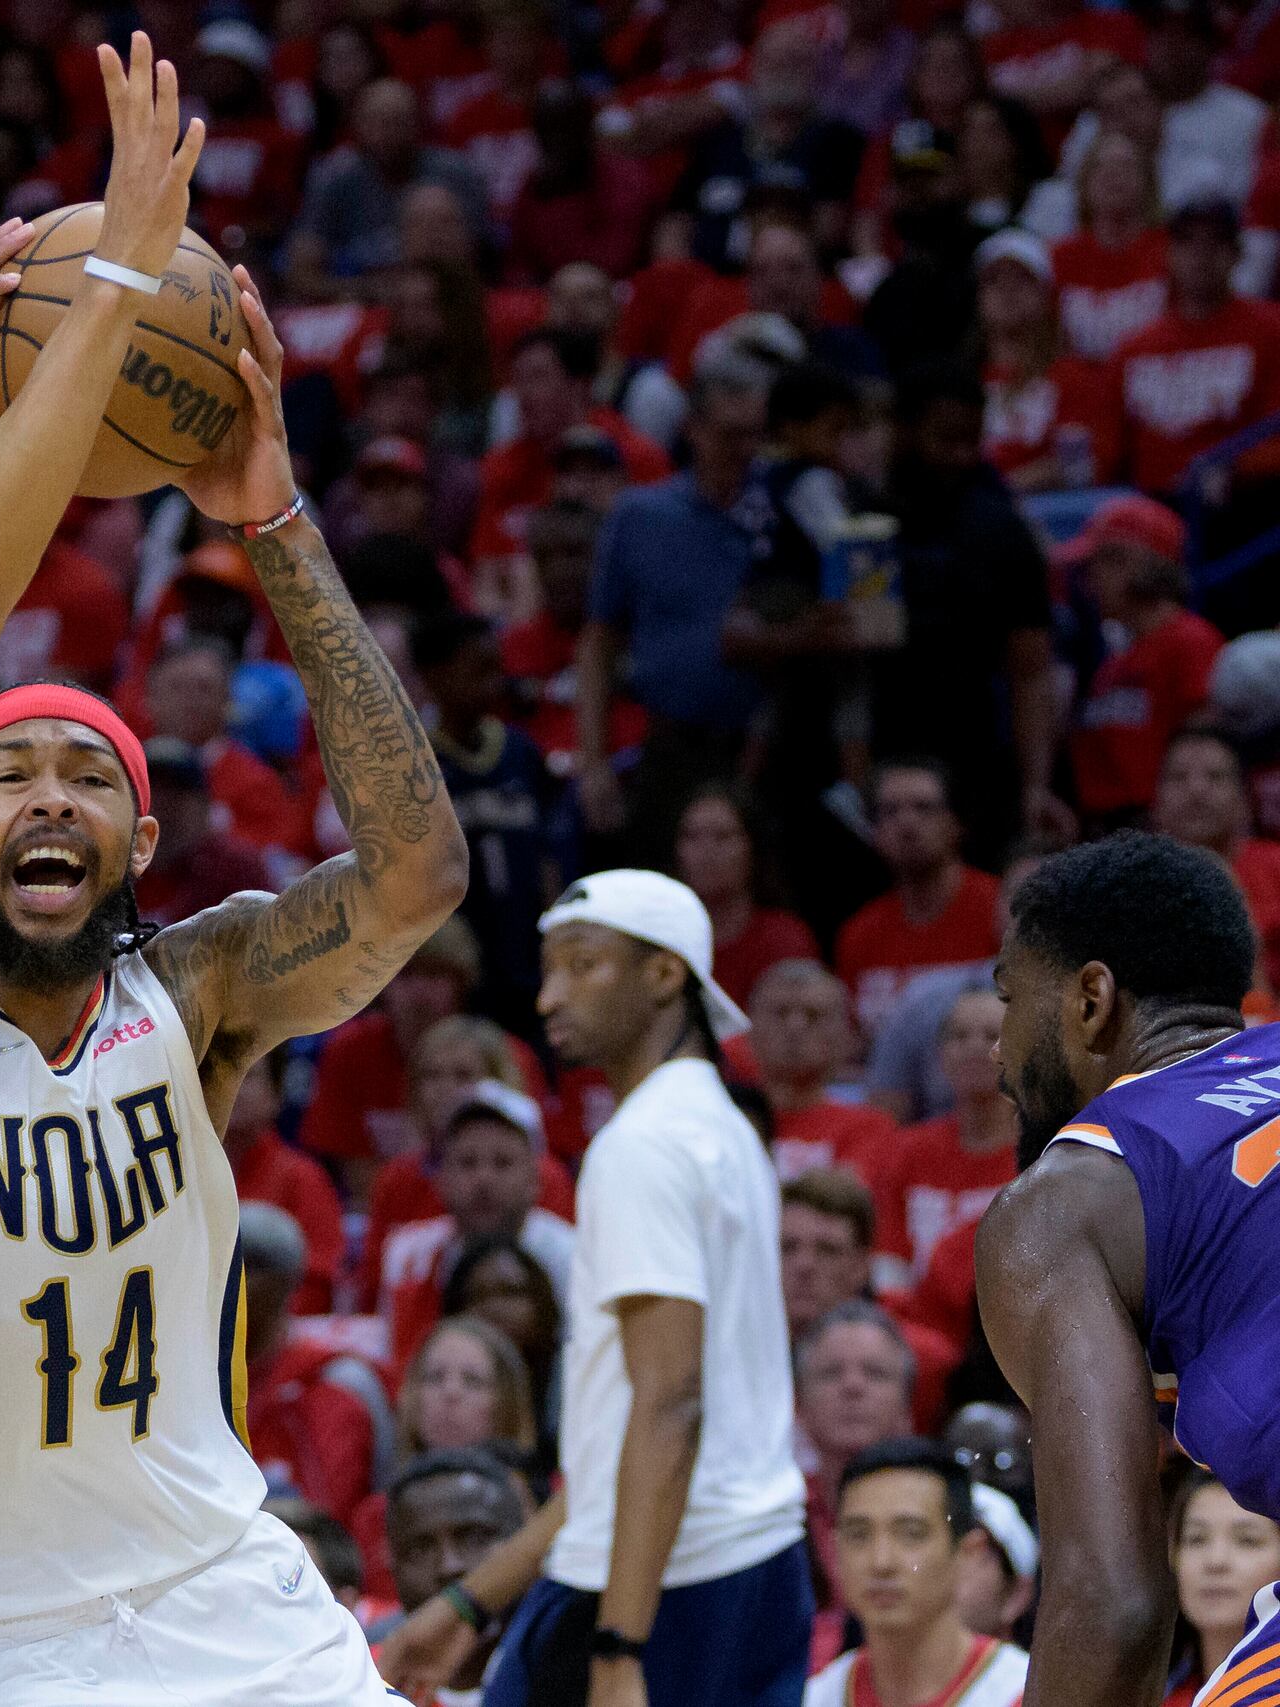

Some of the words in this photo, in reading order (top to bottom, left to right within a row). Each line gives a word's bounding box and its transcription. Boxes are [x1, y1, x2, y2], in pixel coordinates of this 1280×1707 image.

[121, 342, 237, 451] Wilson
[257, 512, 290, 534] FAILURE
[20, 1264, 160, 1450] 14
